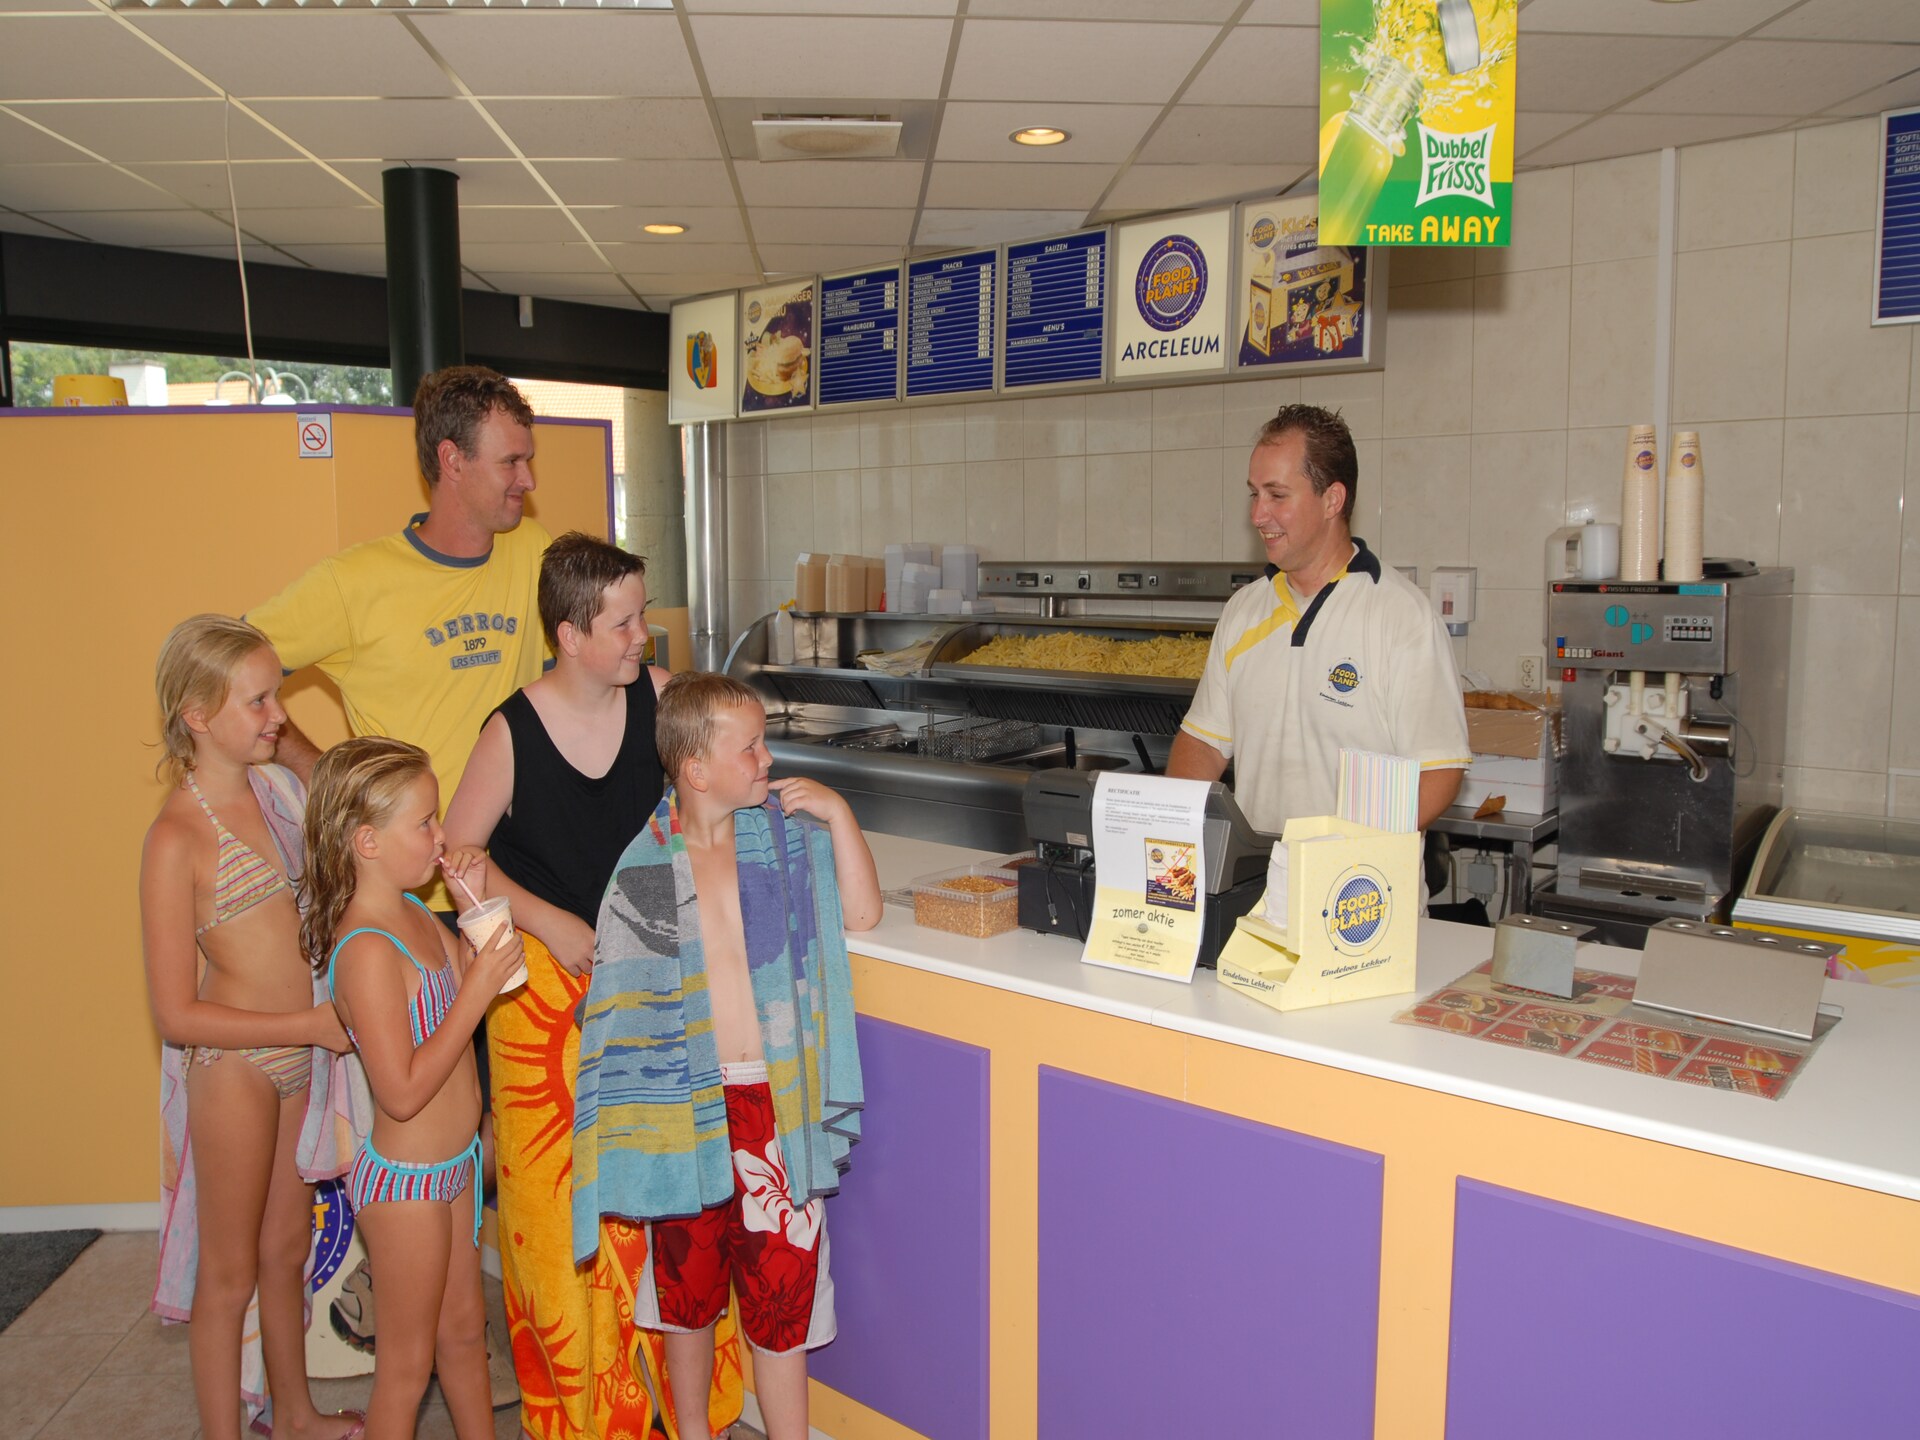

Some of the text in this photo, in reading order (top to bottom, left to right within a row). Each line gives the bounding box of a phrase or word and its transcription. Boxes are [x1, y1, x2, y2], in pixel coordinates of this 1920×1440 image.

[1426, 132, 1488, 159] Dubbel
[1366, 215, 1501, 243] TAKE AWAY
[1045, 243, 1068, 253] SAUZEN
[942, 260, 963, 271] SNACKS
[1152, 265, 1191, 286] FOOD
[1145, 277, 1199, 304] PLANET
[843, 321, 875, 332] HAMBURGERS
[1042, 322, 1065, 332] MENU'S
[1121, 334, 1220, 361] ARCELEUM
[463, 637, 487, 651] 1879
[1593, 649, 1625, 658] Giant
[1328, 674, 1359, 688] PLANET
[1334, 668, 1356, 679] FOOD
[1337, 890, 1380, 914] FOOD
[1112, 908, 1175, 928] zomer aktie
[1330, 902, 1388, 934] PLANET
[1222, 969, 1249, 984] Eindeloos
[1321, 963, 1358, 978] Eindeloos
